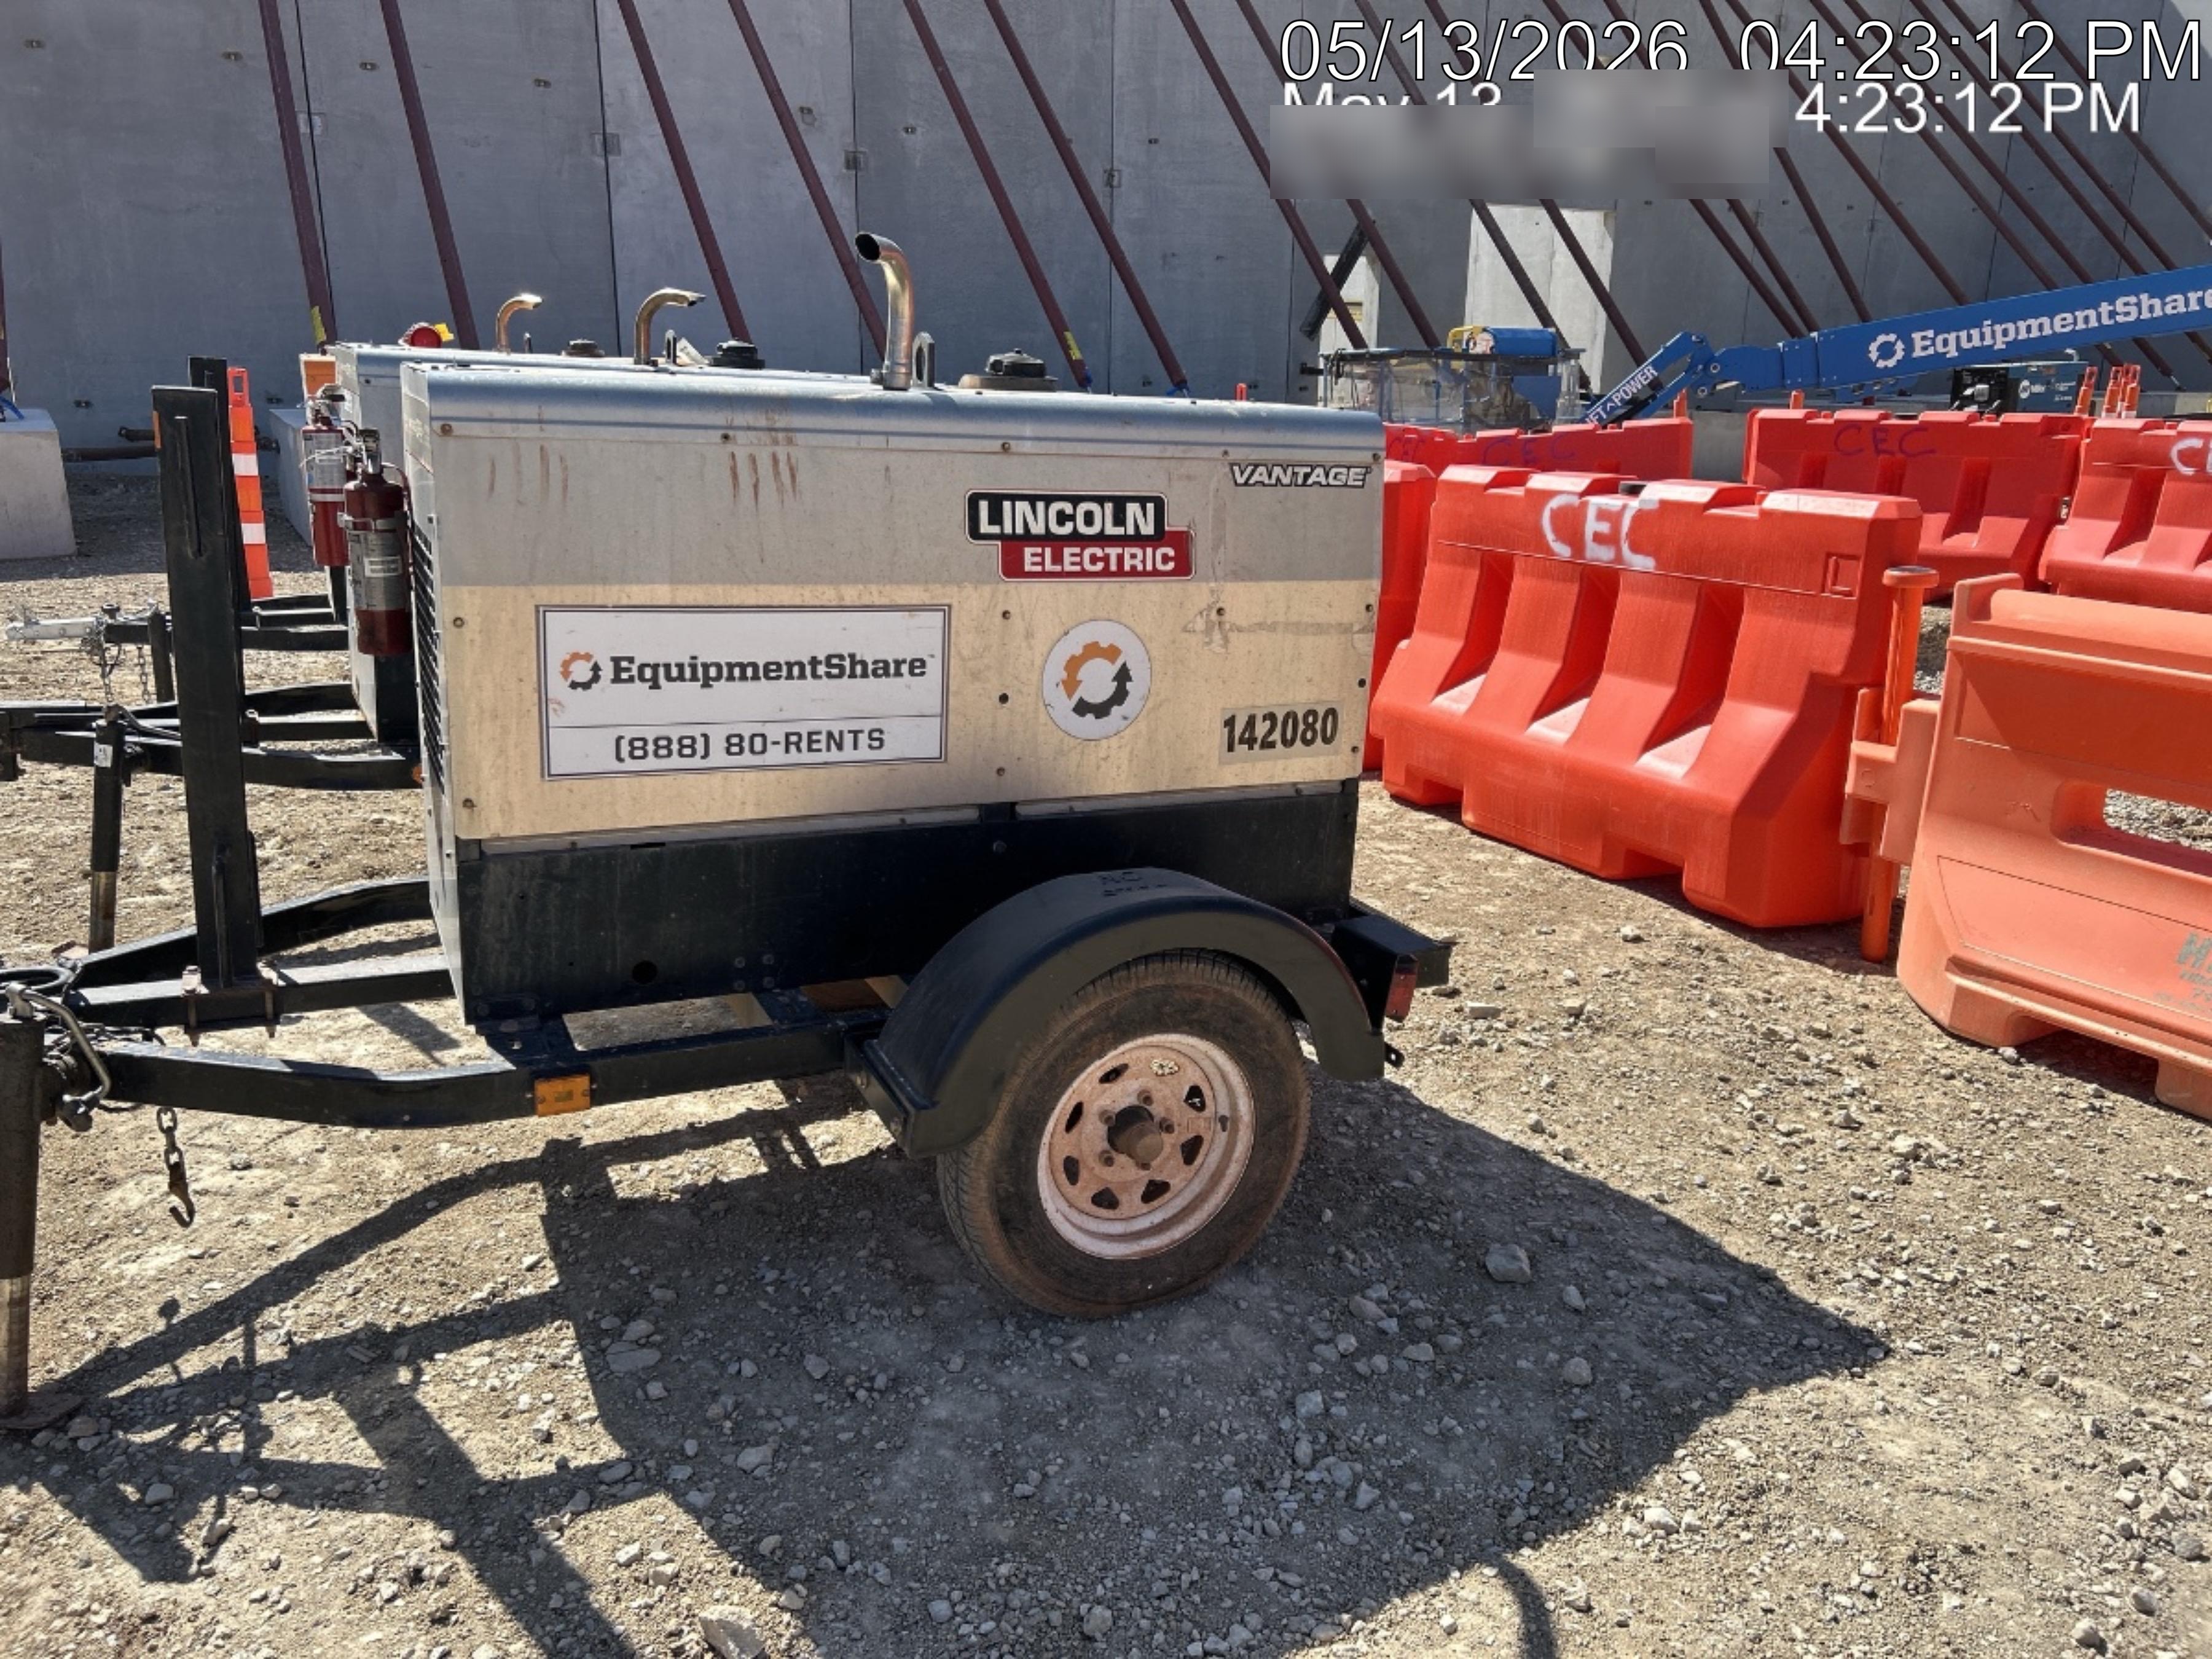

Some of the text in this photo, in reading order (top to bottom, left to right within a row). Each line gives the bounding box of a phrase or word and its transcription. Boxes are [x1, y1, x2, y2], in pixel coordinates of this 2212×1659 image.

[1612, 366, 1658, 406] POWER
[1834, 424, 1937, 457] CEC
[2170, 437, 2212, 476] C
[1231, 464, 1368, 488] VANTAGE
[978, 500, 1155, 536] LINCOLN
[1542, 493, 1660, 571] CEC
[1024, 547, 1175, 573] ELECTRIC
[610, 653, 927, 689] EquipmentShare
[615, 728, 885, 763] (888) 80-RENTS
[1223, 707, 1339, 753] 142080
